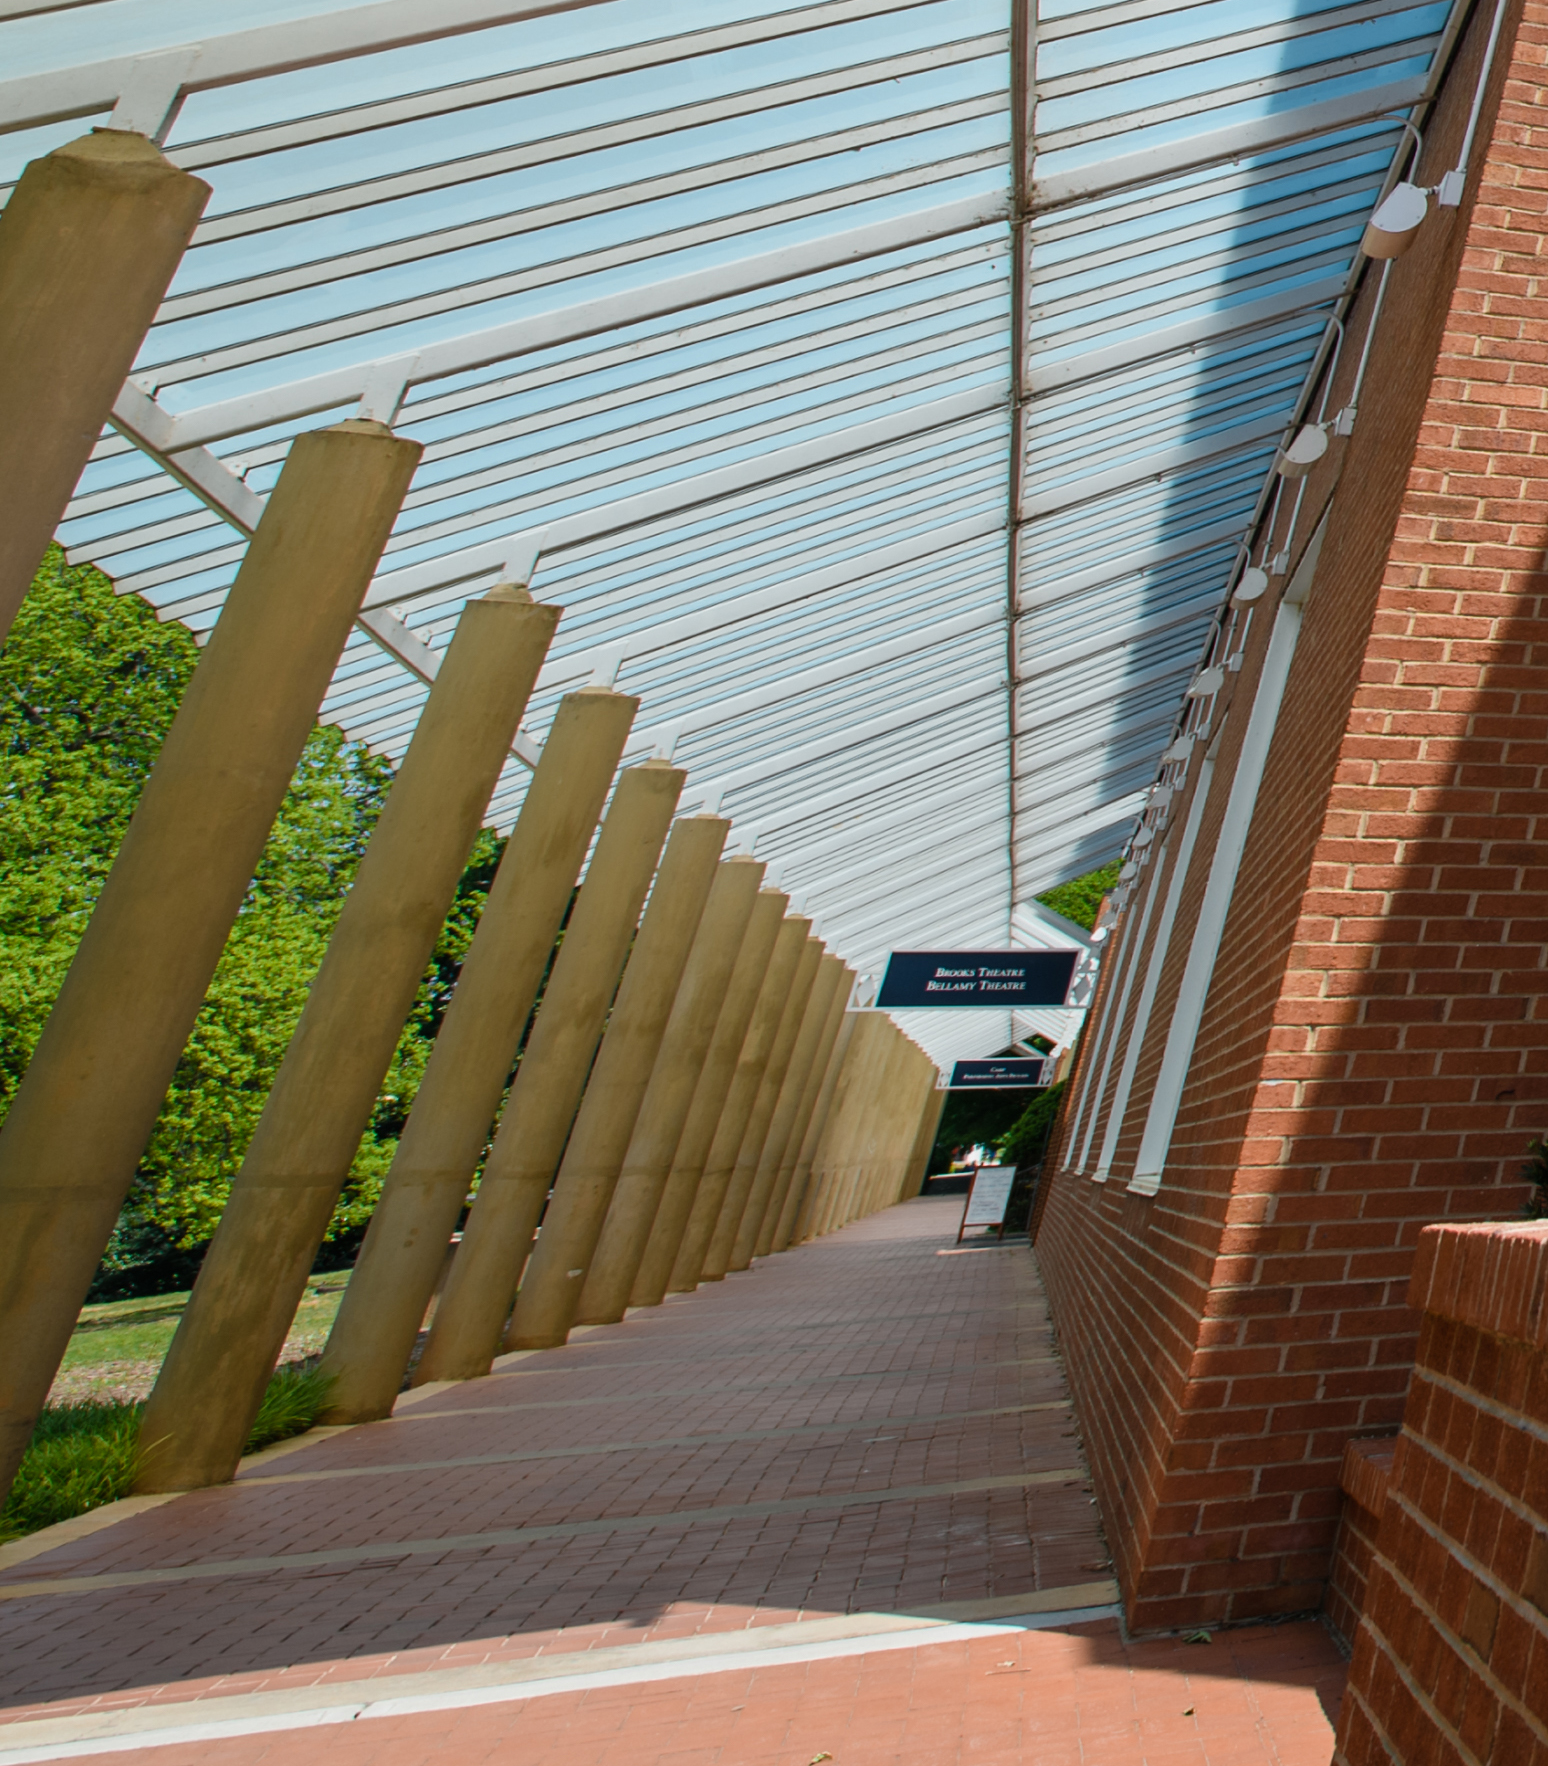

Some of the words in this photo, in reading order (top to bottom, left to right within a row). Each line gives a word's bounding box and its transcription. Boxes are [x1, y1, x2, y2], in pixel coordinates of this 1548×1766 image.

[934, 967, 976, 978] BROOKS
[978, 967, 1026, 977] THEATRE
[925, 980, 977, 991] BELLAMY
[979, 980, 1027, 991] THEATRE
